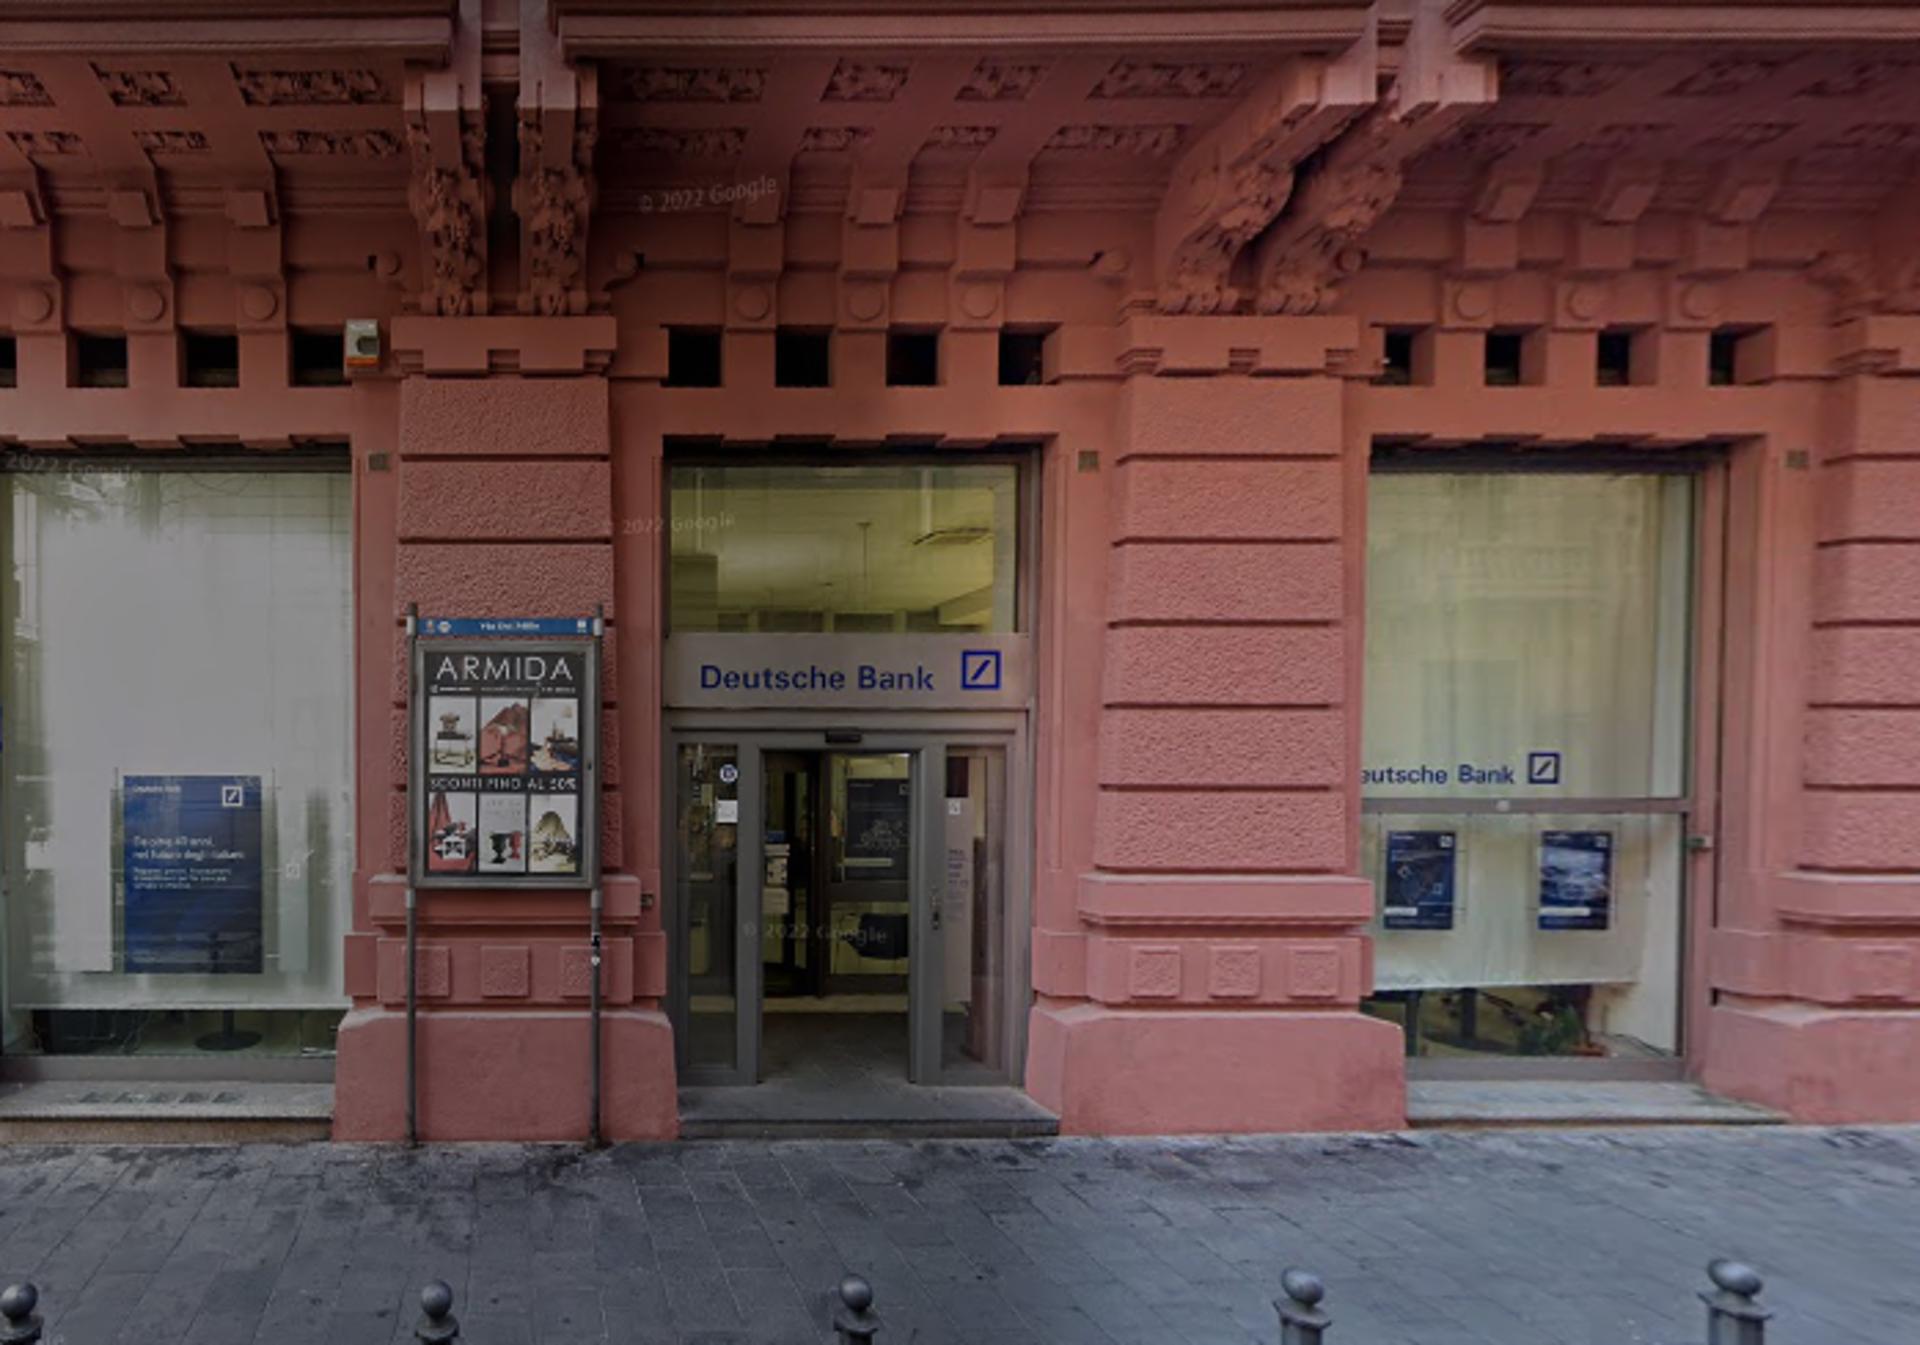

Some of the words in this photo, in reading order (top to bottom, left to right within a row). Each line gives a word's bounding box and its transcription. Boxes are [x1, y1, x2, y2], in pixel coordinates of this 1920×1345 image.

[436, 655, 574, 681] ARMIDA
[700, 664, 846, 691] Deutsche
[857, 664, 934, 691] Bank
[1360, 764, 1448, 785] eutsche
[1458, 764, 1517, 785] Bank
